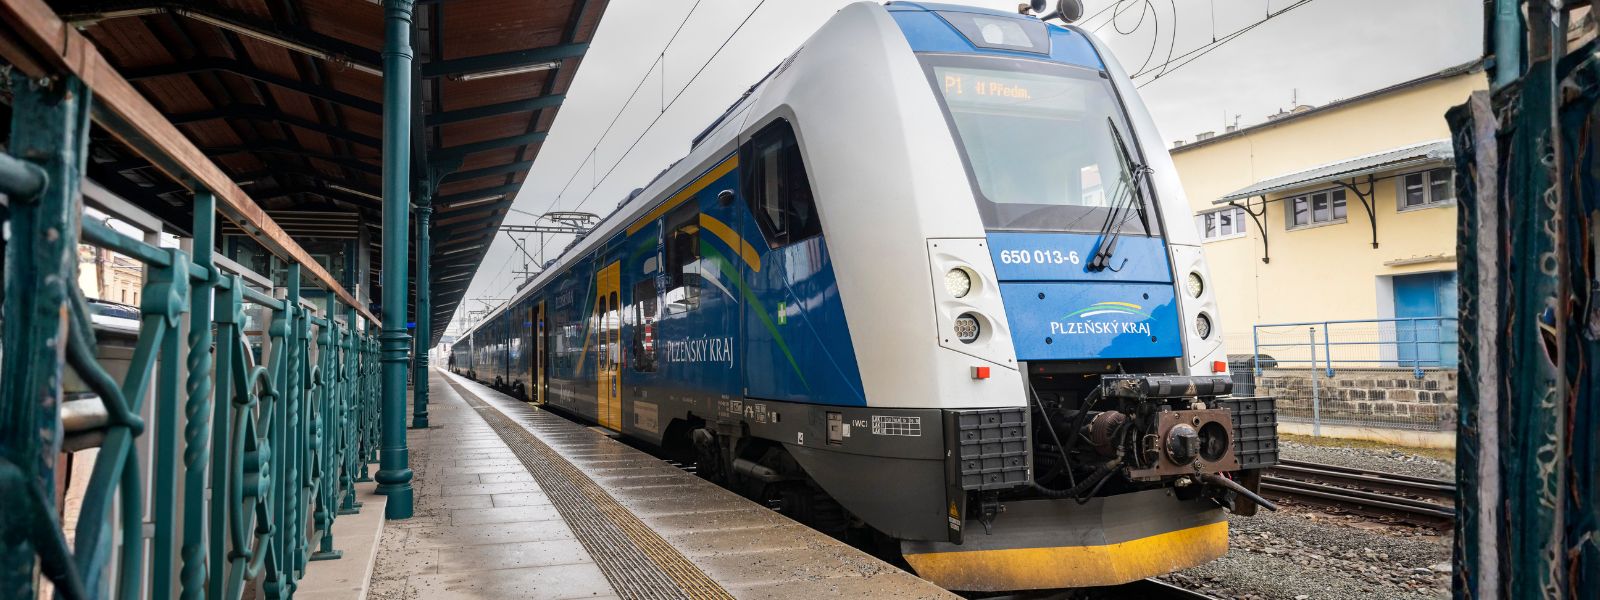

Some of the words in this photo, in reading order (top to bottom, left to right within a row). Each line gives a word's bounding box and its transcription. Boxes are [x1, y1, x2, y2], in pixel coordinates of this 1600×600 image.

[1001, 250, 1031, 265] 650
[1034, 250, 1080, 265] 013-6
[1051, 319, 1119, 334] PLZEŇSKÝ
[1122, 322, 1150, 336] KRAJ
[667, 333, 708, 362] PLZEŇSKÝ
[710, 336, 733, 368] KRAJ
